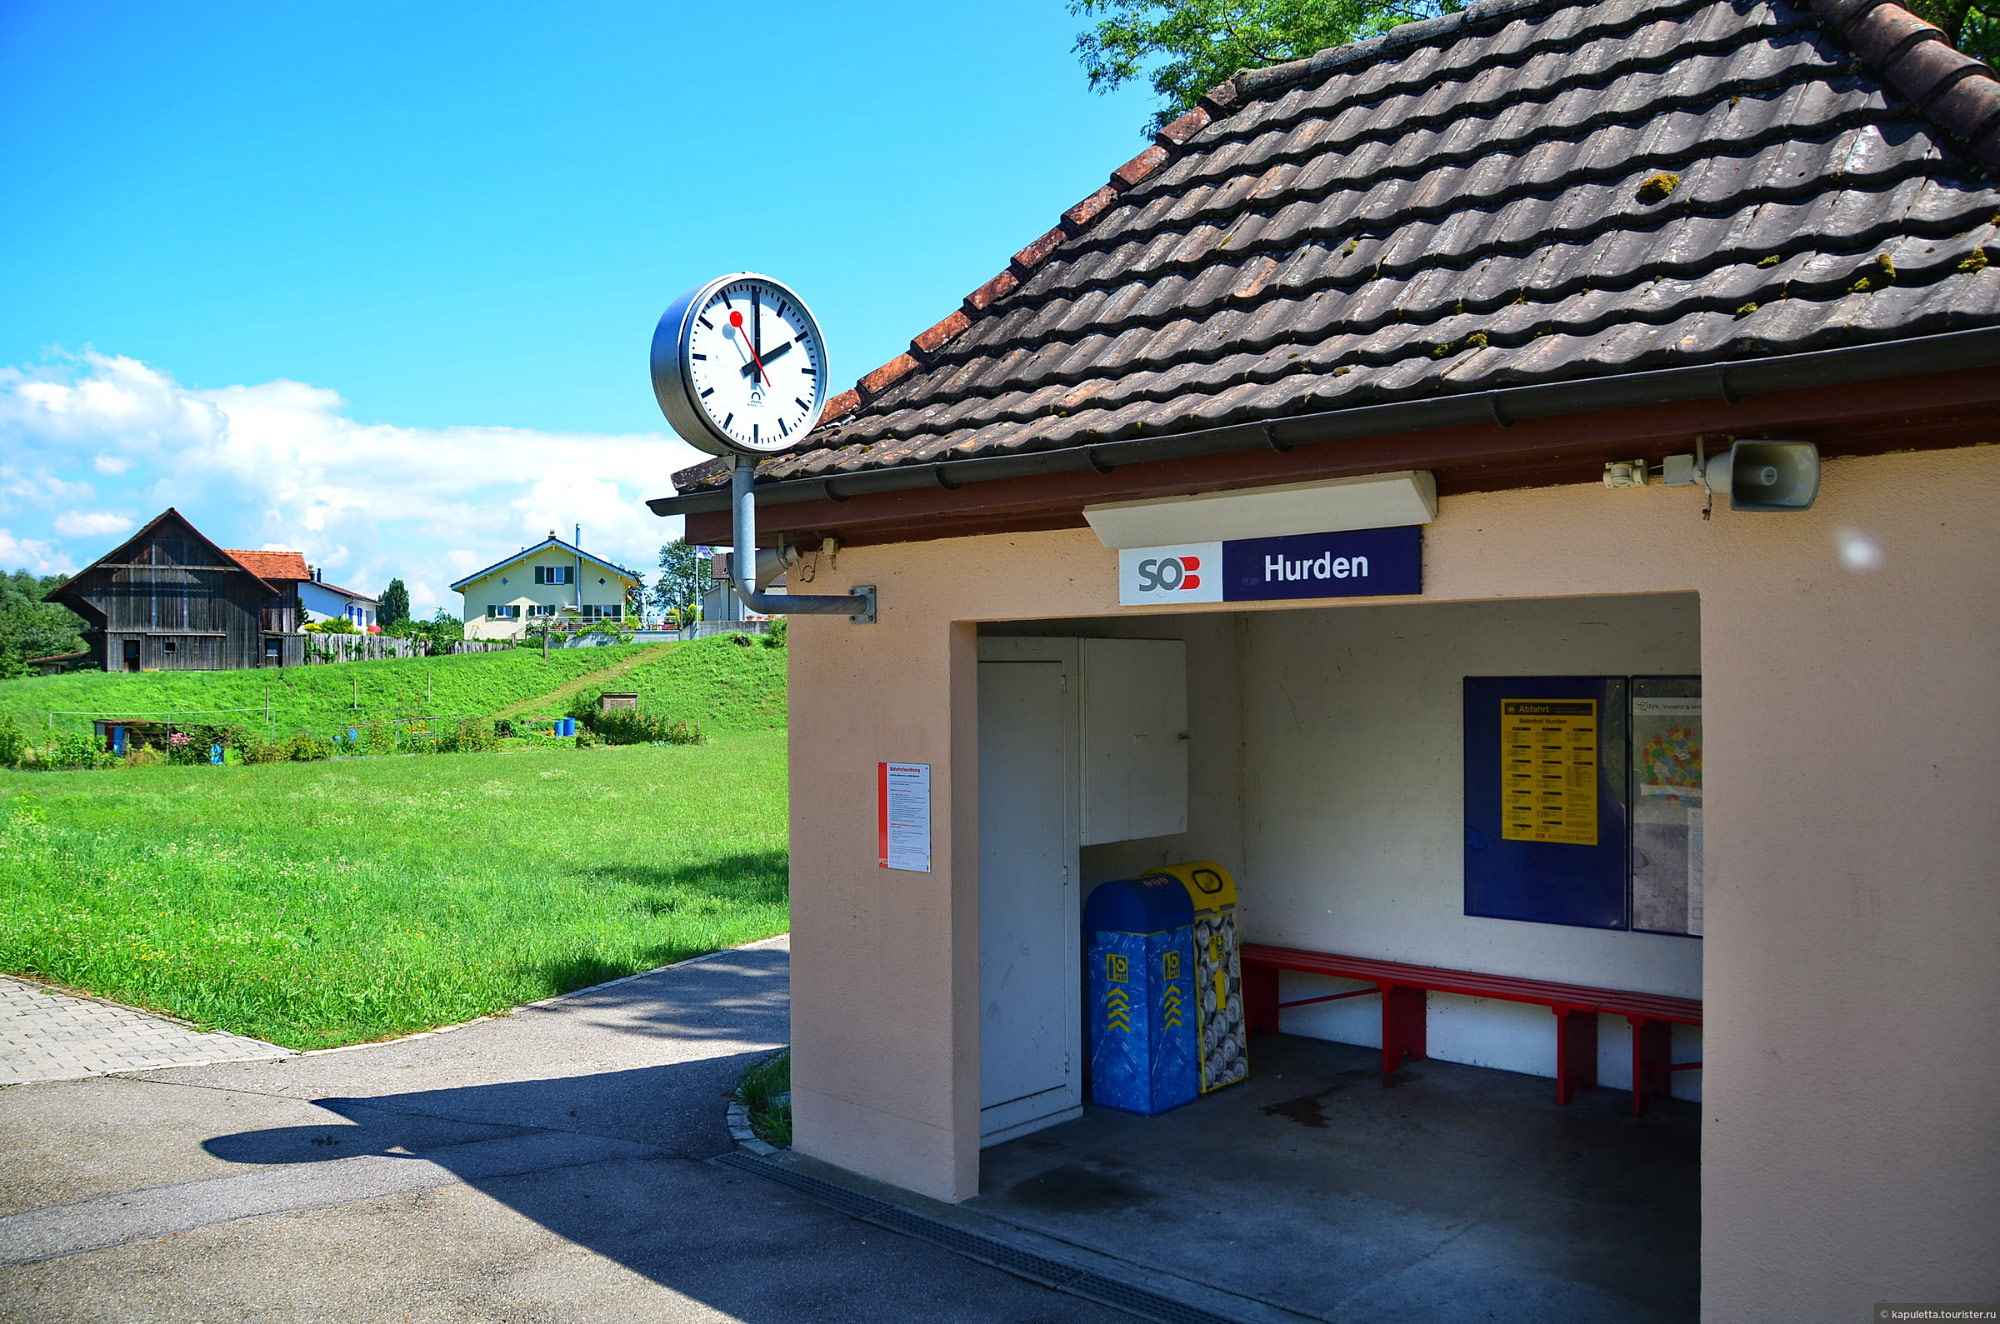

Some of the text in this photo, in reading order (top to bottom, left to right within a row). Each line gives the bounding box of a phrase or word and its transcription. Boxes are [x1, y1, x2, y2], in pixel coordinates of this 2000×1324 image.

[1138, 556, 1201, 592] SOB
[1264, 551, 1369, 582] Hurden
[1519, 704, 1549, 713] Abfahrt
